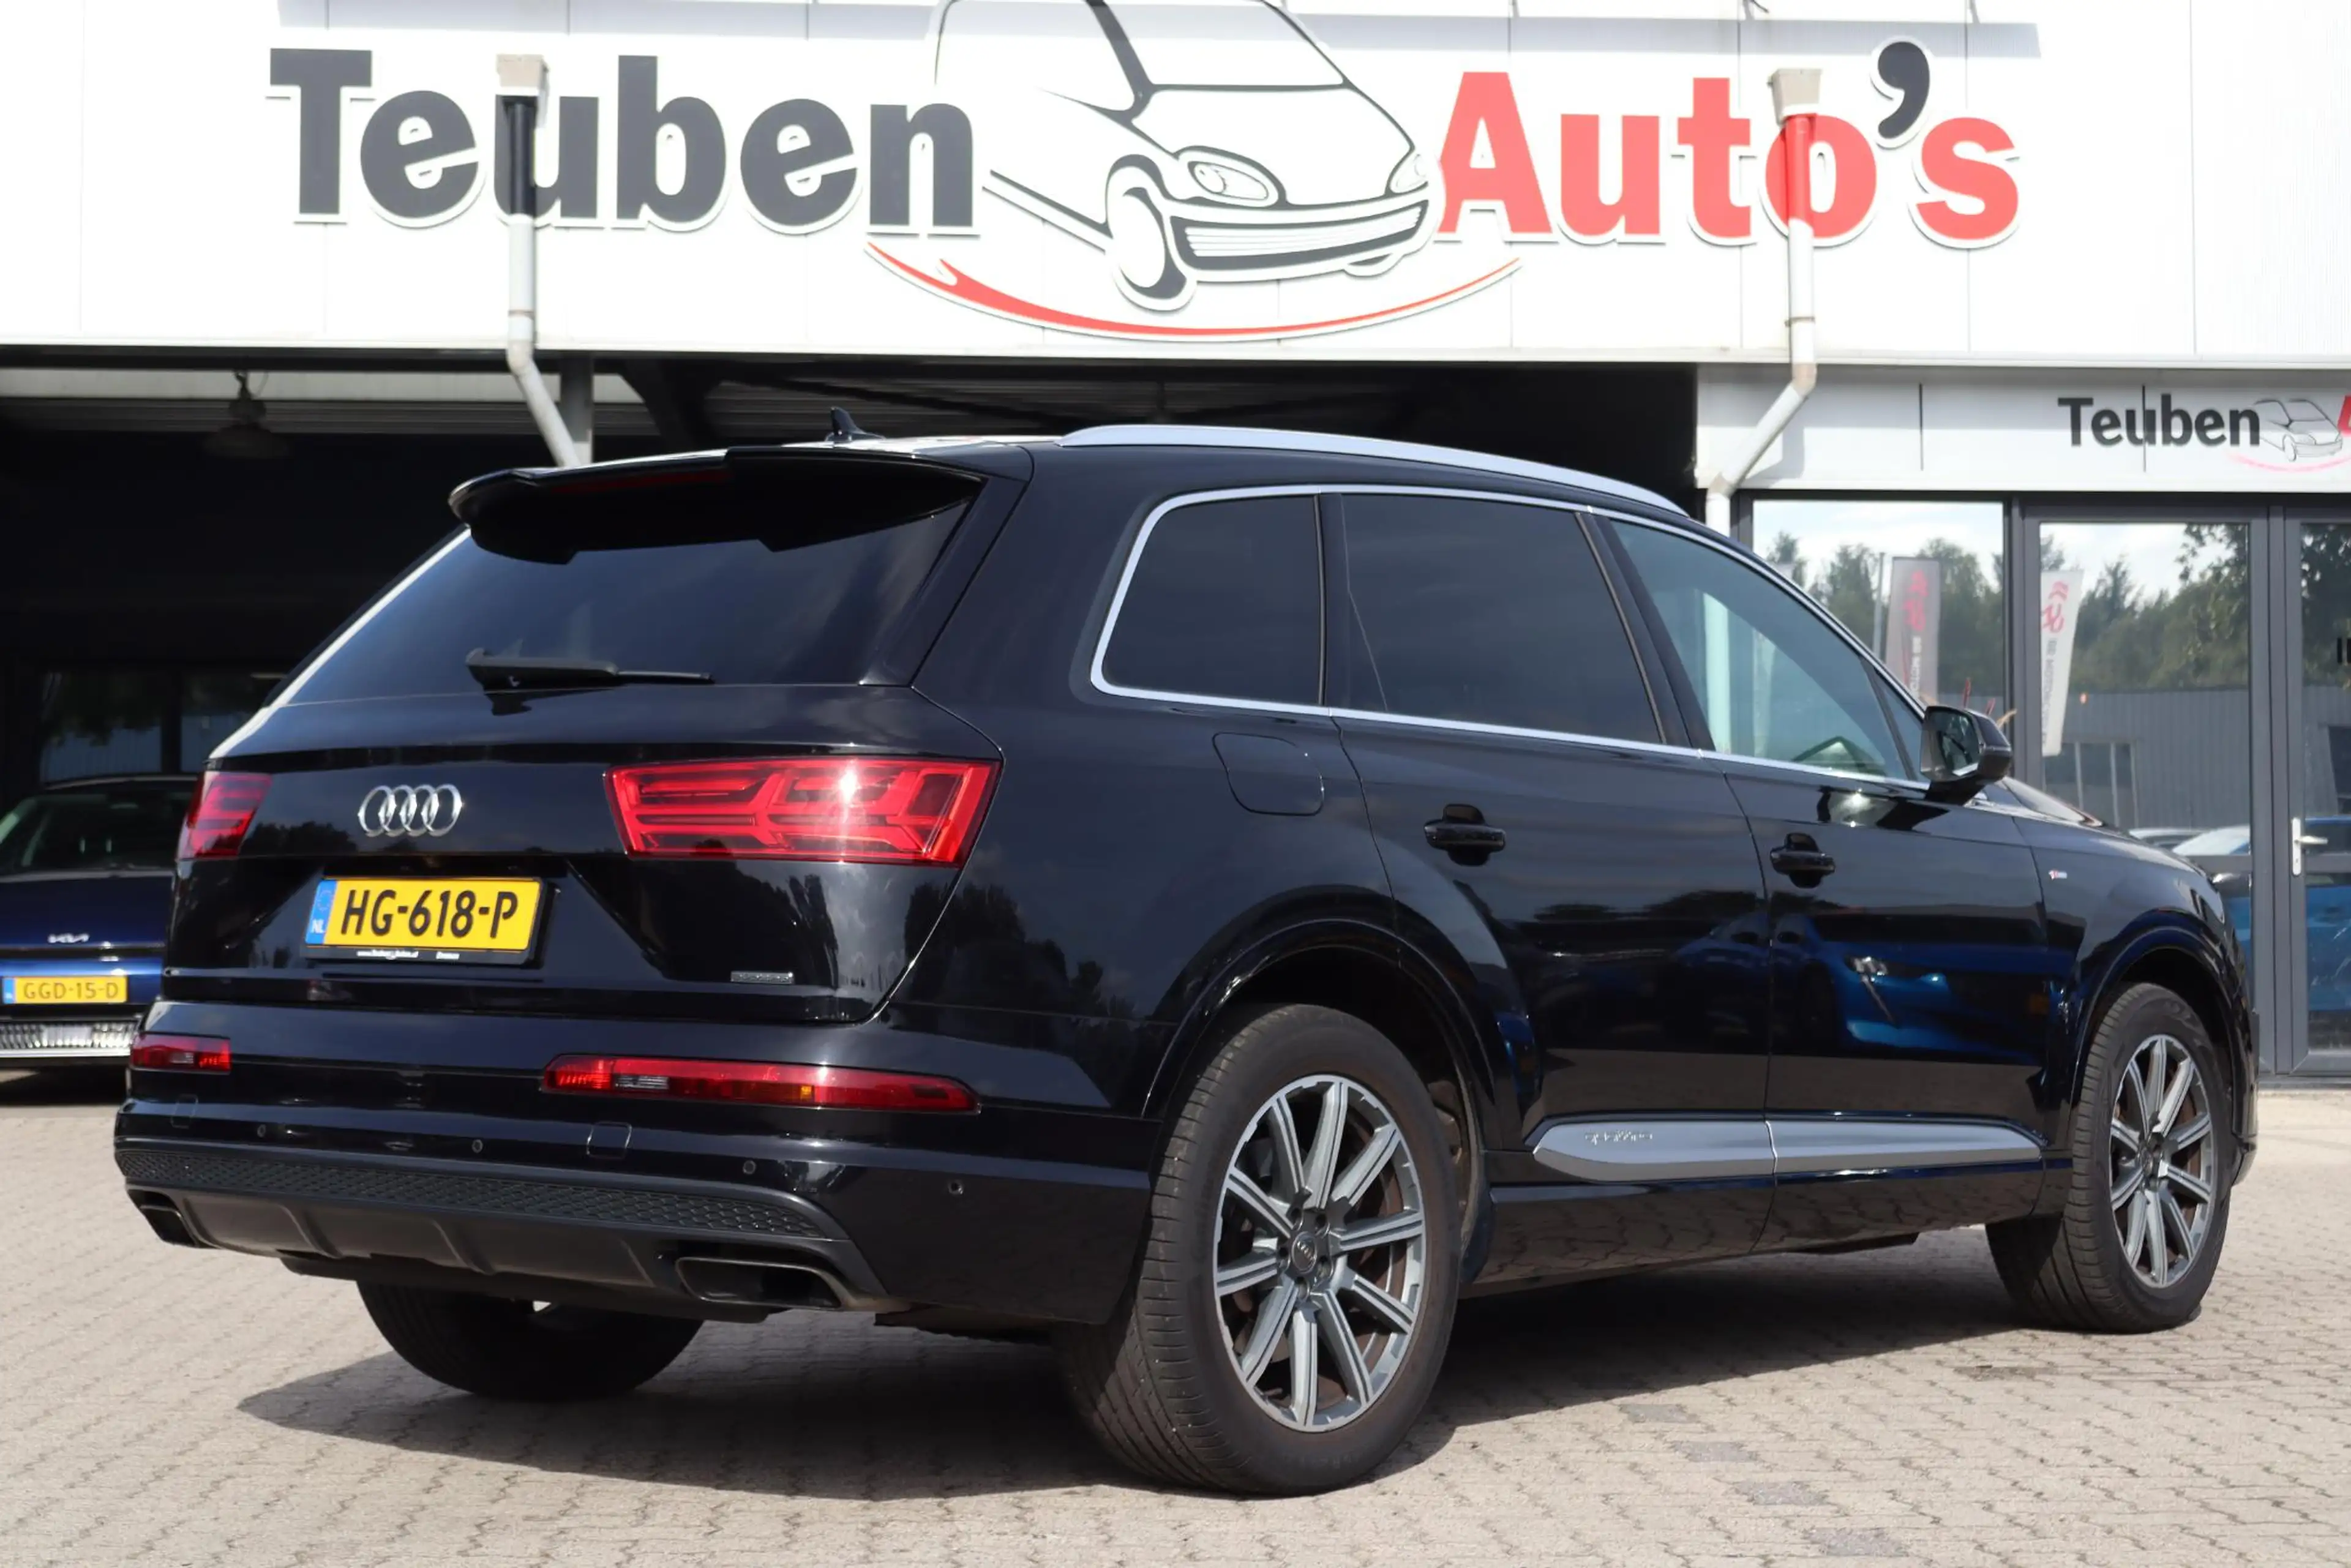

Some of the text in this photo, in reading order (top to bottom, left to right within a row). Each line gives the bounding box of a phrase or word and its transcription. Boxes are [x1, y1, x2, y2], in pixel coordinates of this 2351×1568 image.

[269, 41, 2019, 241] Teuben Auto's
[2058, 394, 2260, 446] Teuben
[340, 889, 519, 939] HG-618-P
[23, 982, 119, 999] GGD-15-D
